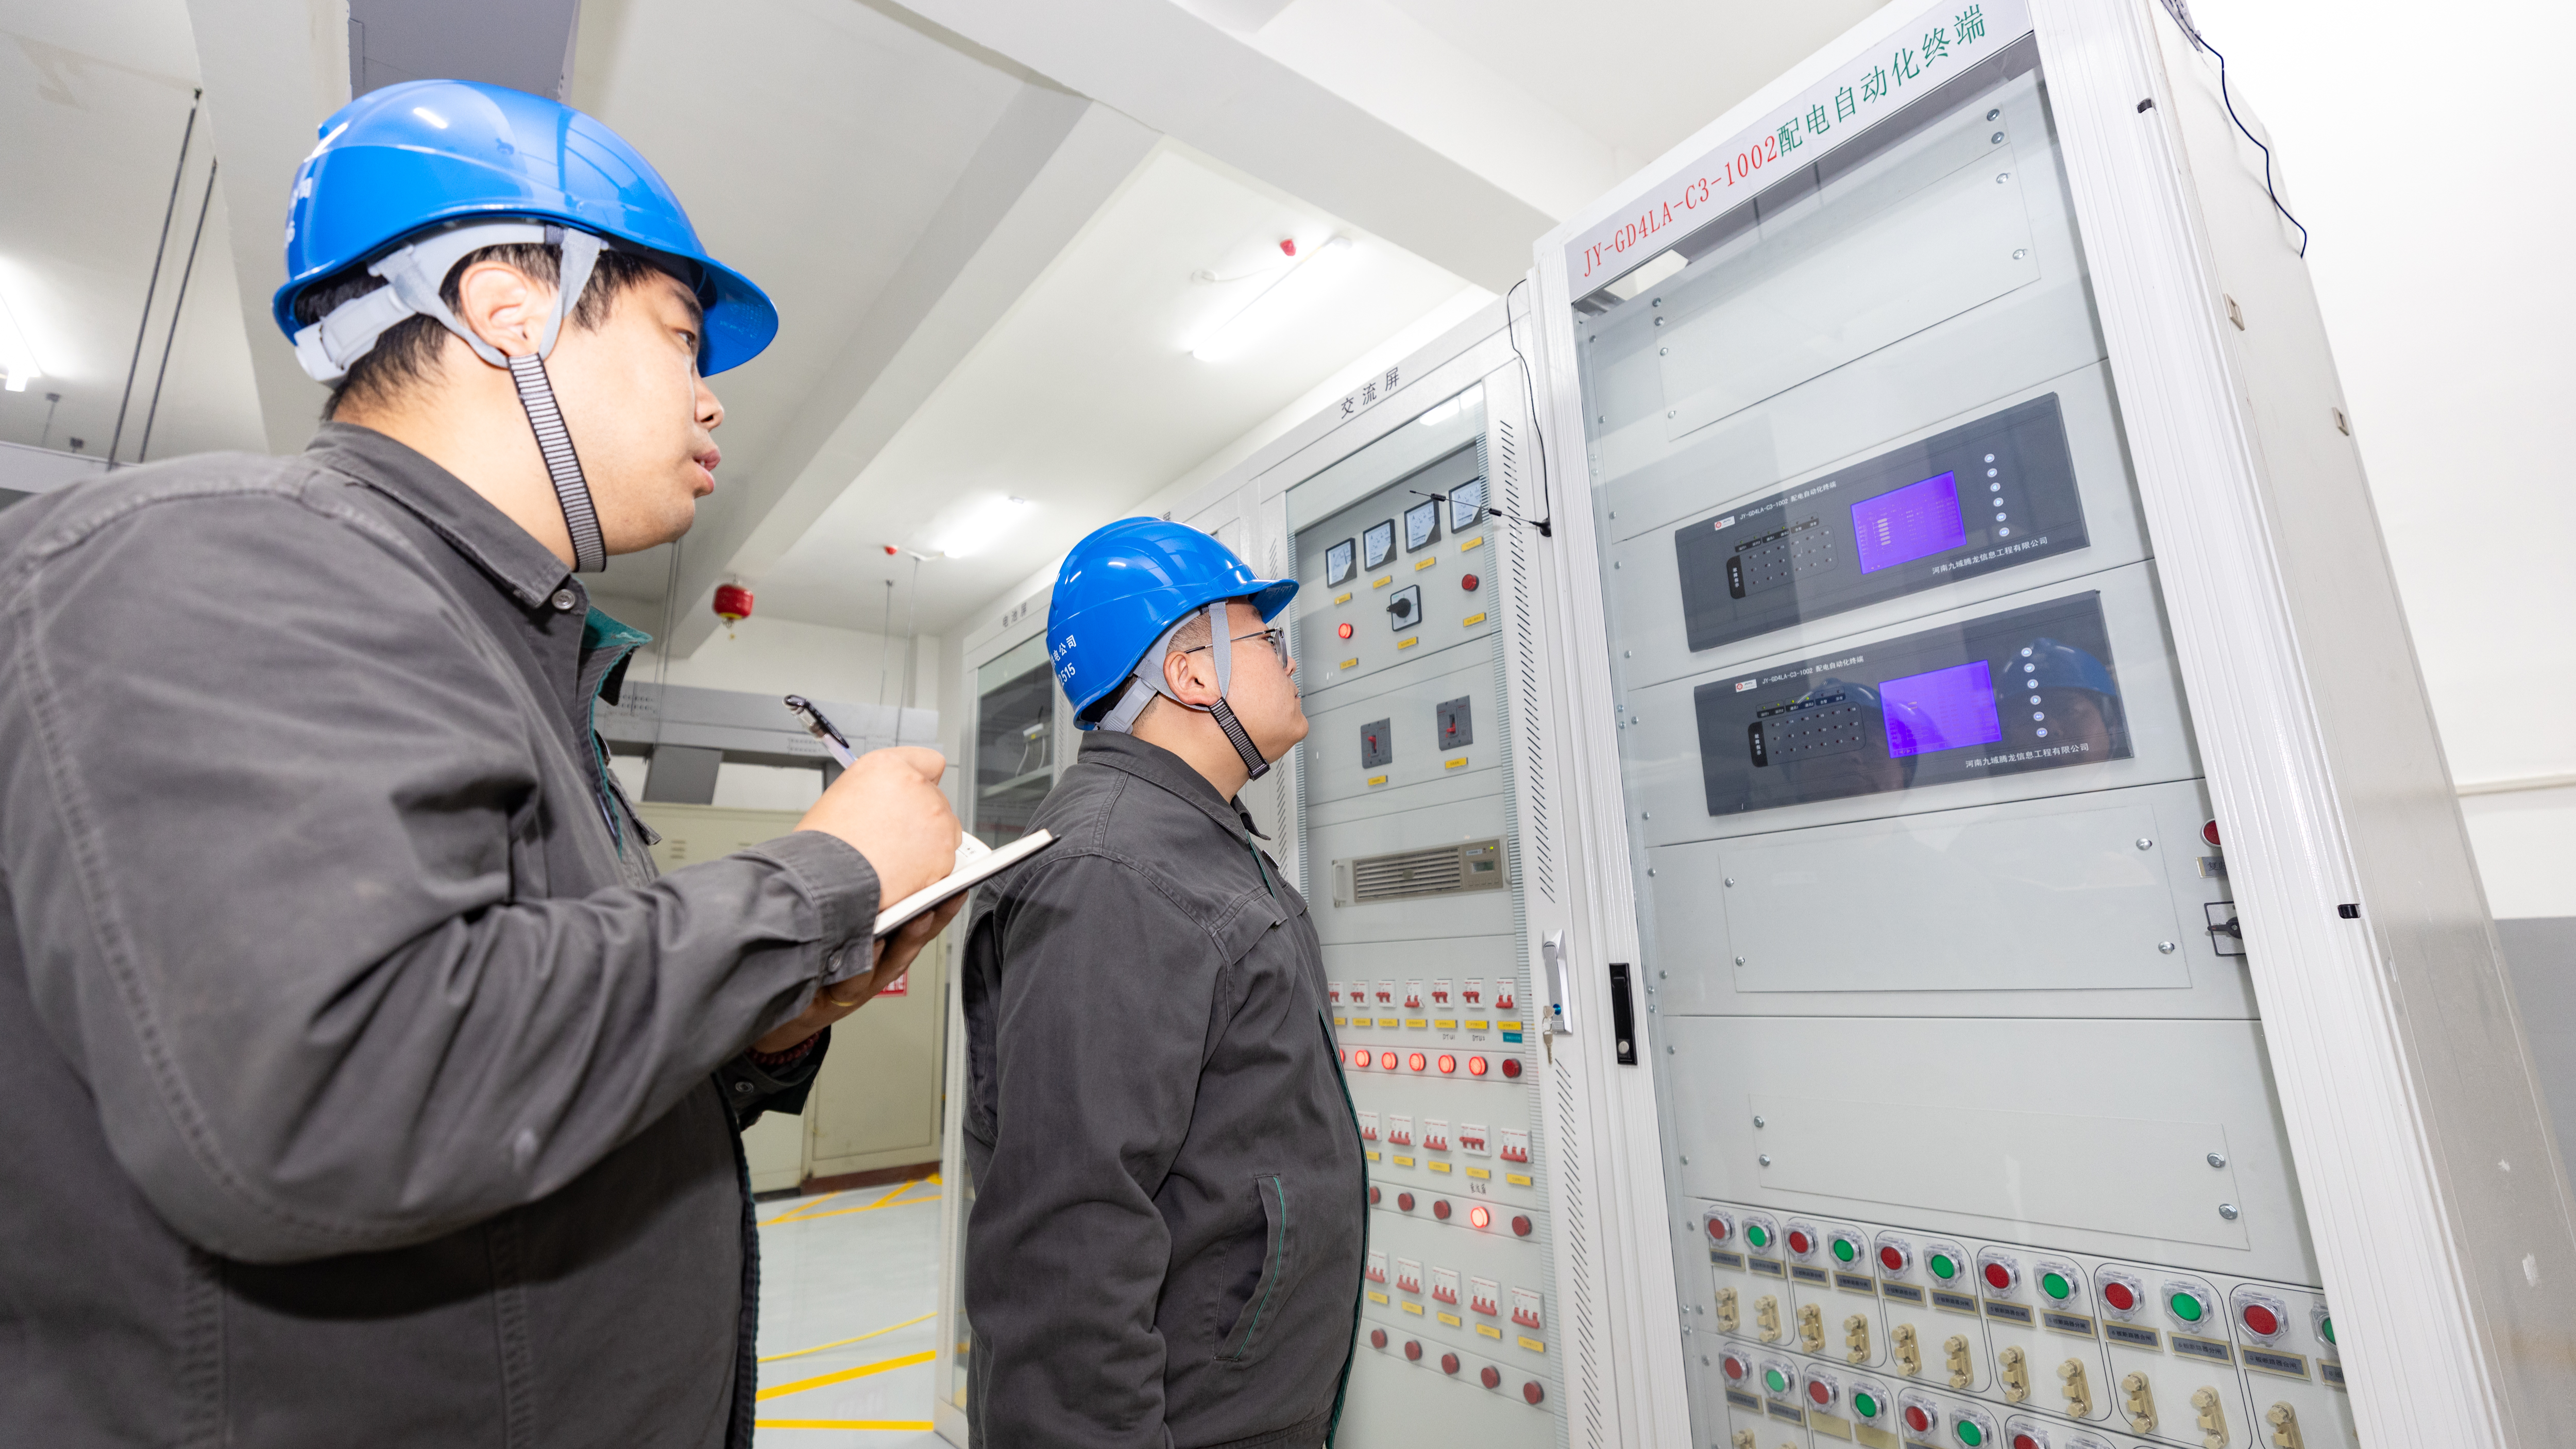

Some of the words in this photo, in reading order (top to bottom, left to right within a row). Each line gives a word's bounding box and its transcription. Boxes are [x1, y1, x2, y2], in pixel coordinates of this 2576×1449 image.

[1341, 366, 1399, 419] 交流屏
[1740, 498, 1788, 520] JY-GD4LA-C3-1002
[1790, 481, 1837, 502] 配电自动化终端
[1932, 536, 2048, 575] 河南九域腾龙信息工程有限公司
[1003, 602, 1027, 628] 电池屏
[1762, 667, 1813, 684] JY-GD4LA-C3-1002
[1816, 655, 1864, 672] 配电自动化终端
[1965, 743, 2090, 768] 河南九域腾龙信息工程有限公司
